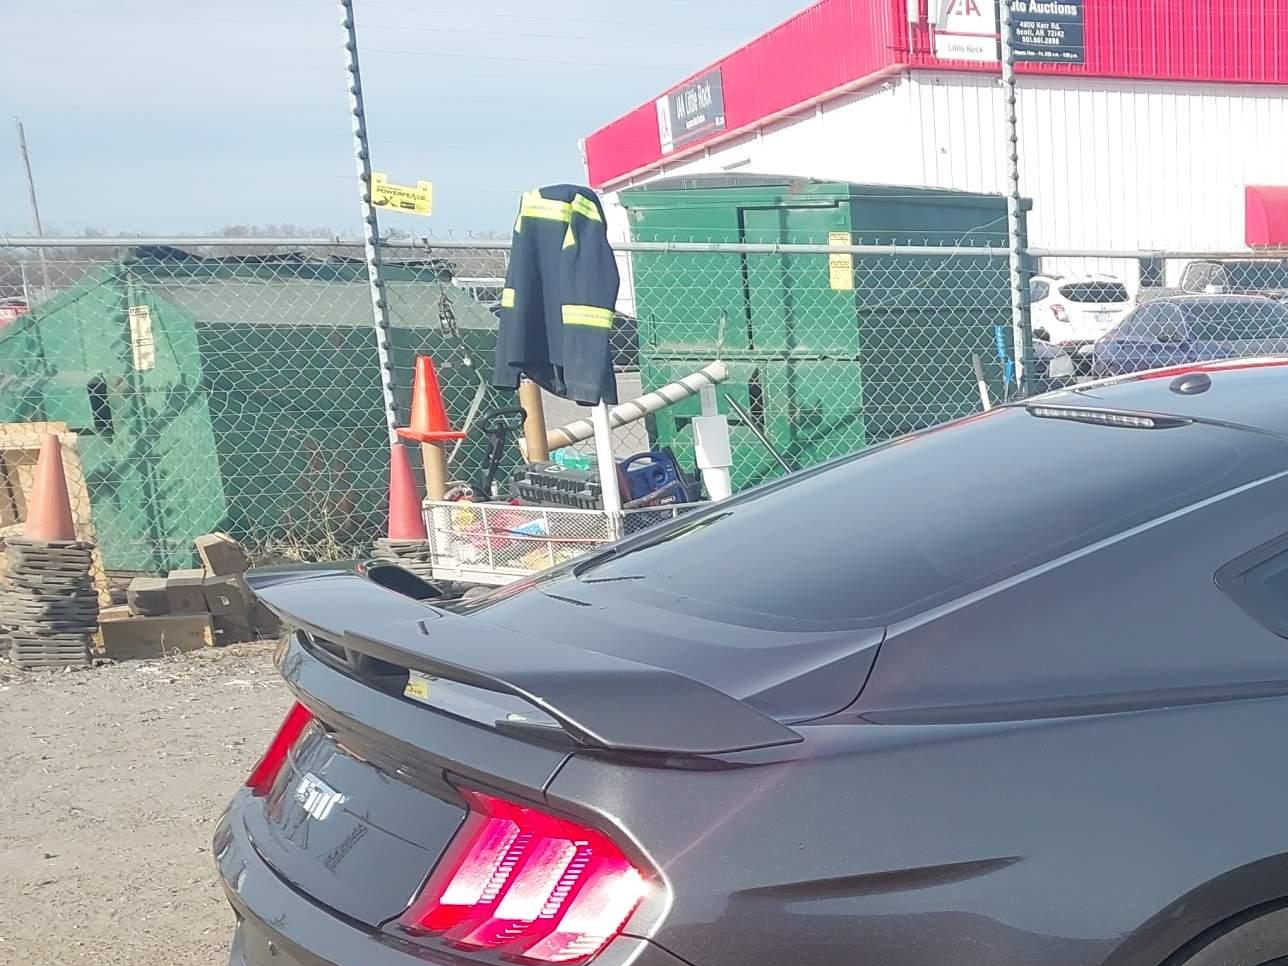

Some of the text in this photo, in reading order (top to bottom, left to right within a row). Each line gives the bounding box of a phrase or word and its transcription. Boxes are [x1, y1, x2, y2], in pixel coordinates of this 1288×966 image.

[1010, 0, 1077, 15] uto Auctions
[966, 45, 983, 53] Rock
[697, 80, 712, 109] Rock
